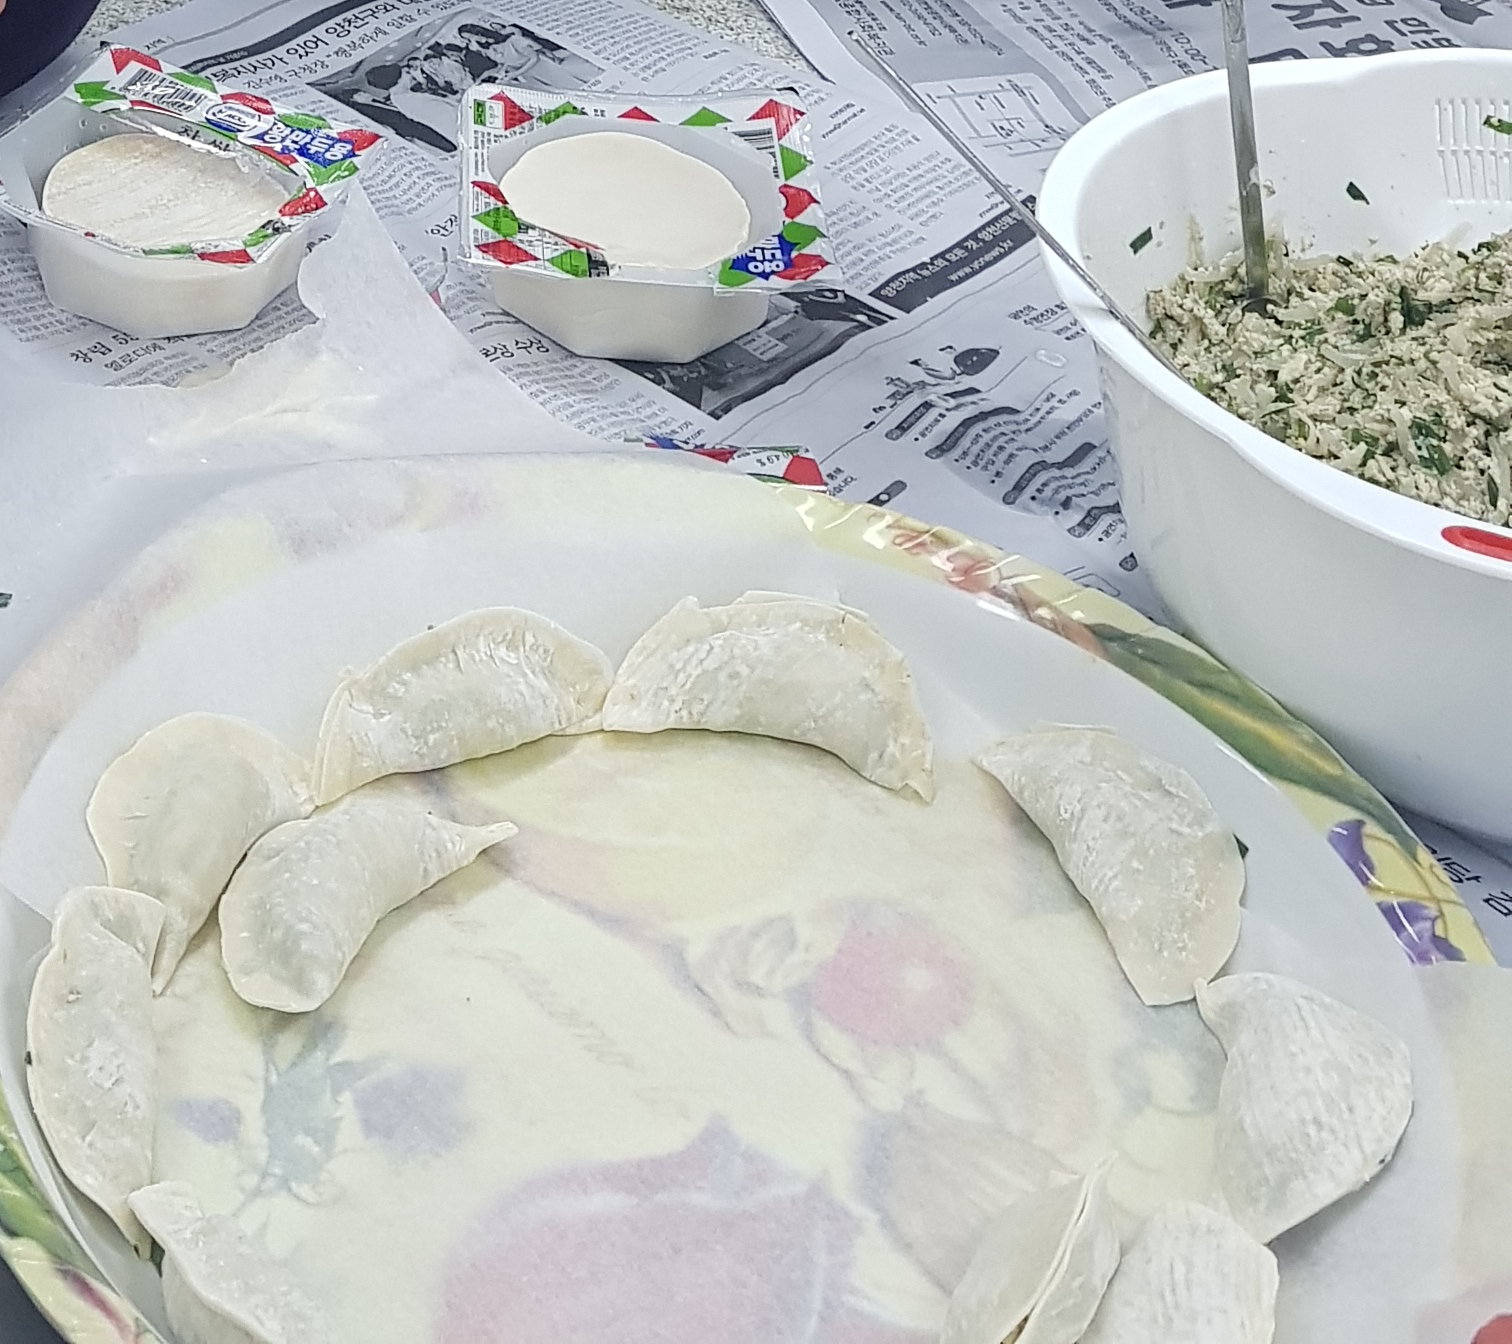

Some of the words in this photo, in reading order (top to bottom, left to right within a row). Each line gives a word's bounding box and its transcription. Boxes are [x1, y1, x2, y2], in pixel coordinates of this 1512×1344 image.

[204, 55, 289, 82] 복지사가
[285, 34, 328, 61] 있어
[324, 3, 400, 38] 양천구와
[512, 336, 550, 356] 수상
